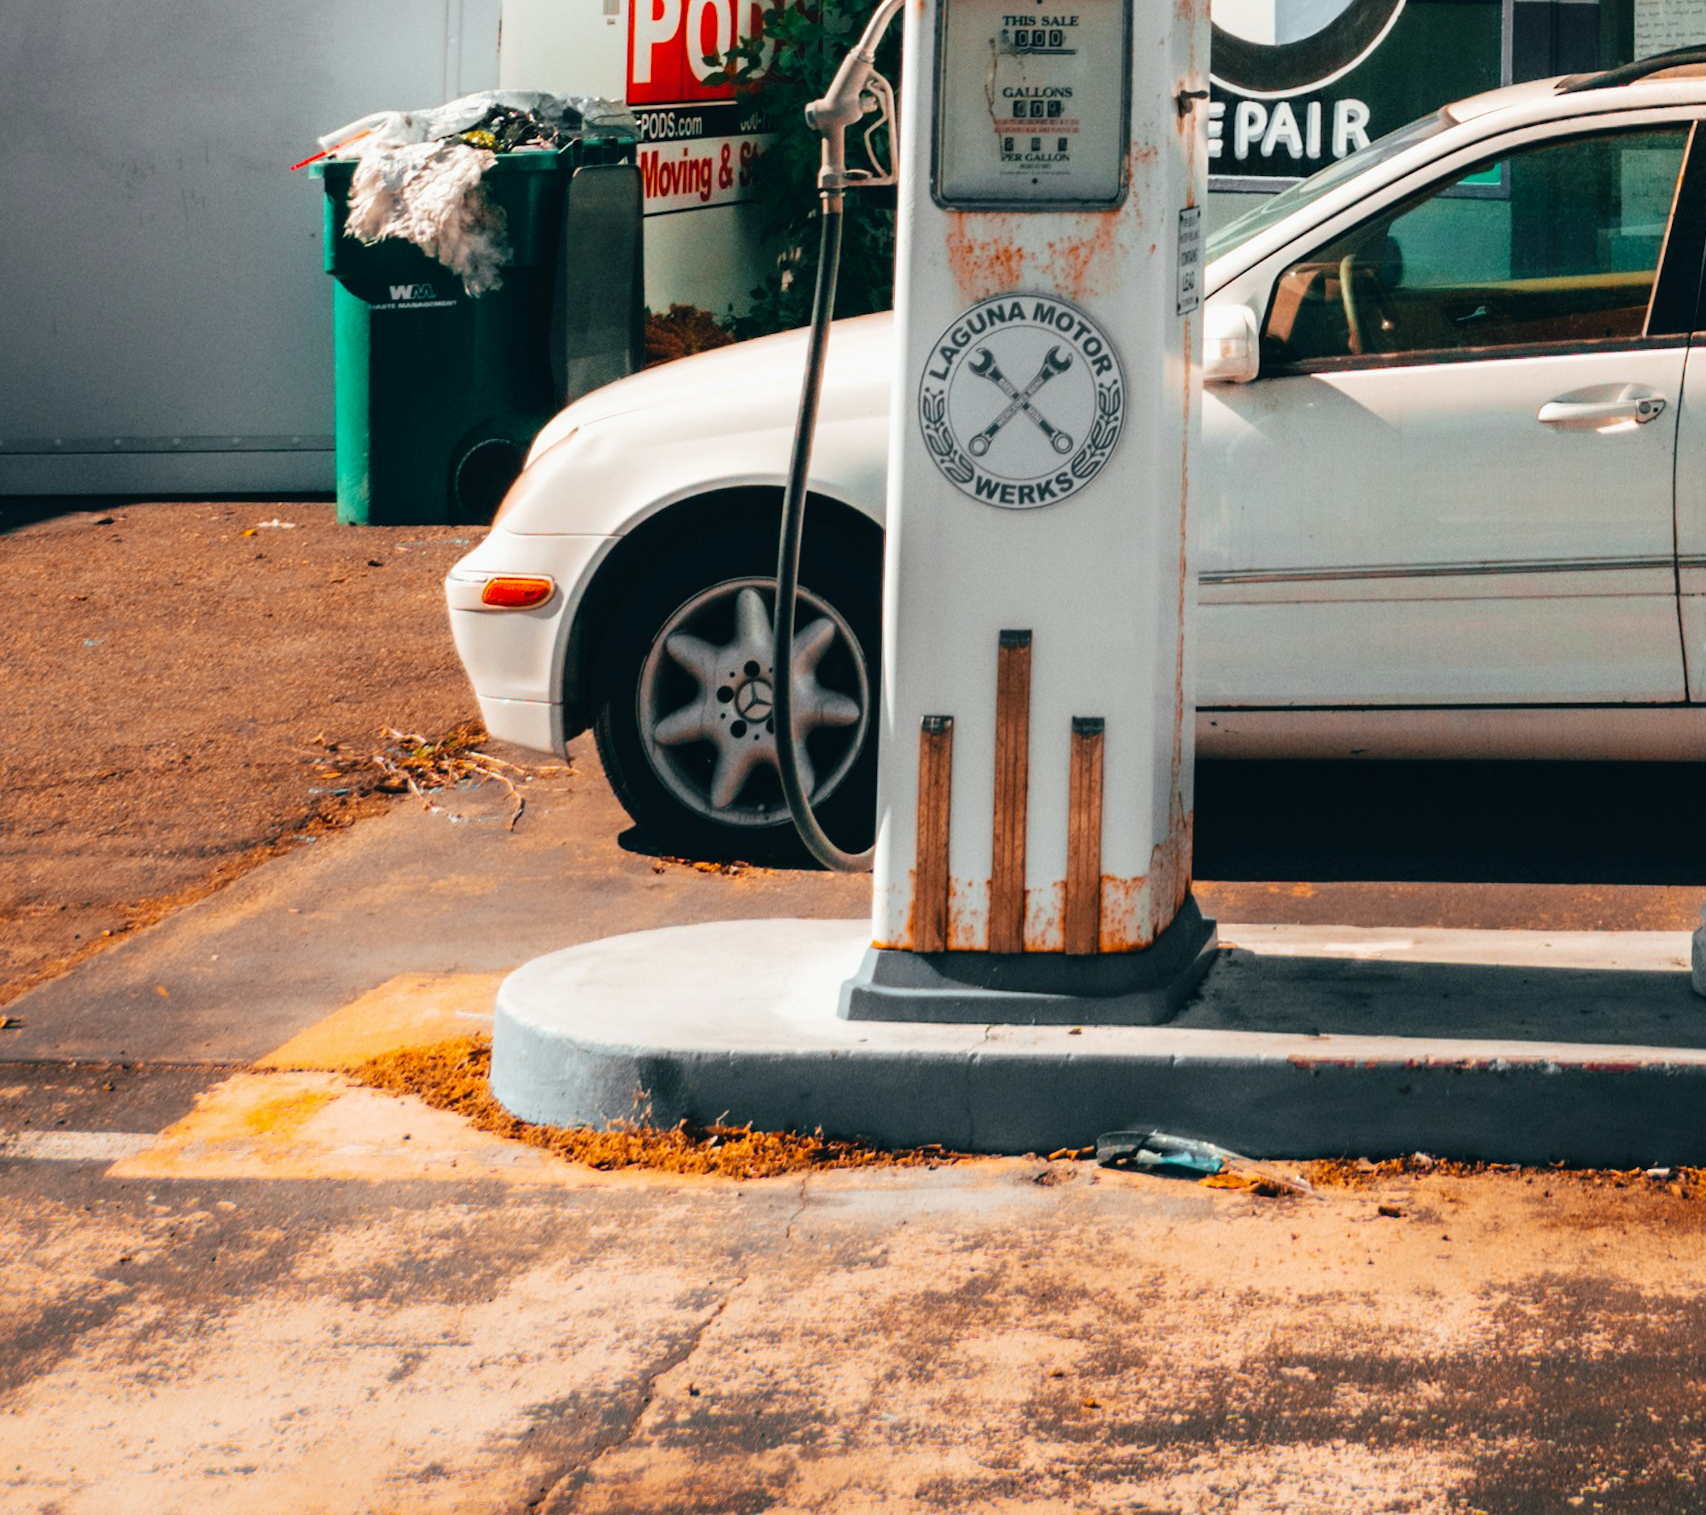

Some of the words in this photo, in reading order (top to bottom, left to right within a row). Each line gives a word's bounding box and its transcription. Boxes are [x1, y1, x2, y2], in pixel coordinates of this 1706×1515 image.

[1003, 15, 1037, 27] THIS
[1041, 15, 1079, 27] SALE
[1002, 86, 1073, 98] GALLONS
[640, 111, 704, 140] PODS.com
[639, 147, 713, 202] Moving
[718, 142, 733, 190] &
[1025, 153, 1070, 162] GALLON
[929, 301, 1027, 382] LAGUNA
[1032, 302, 1113, 377] MOTOR
[974, 471, 1075, 505] WERKS
